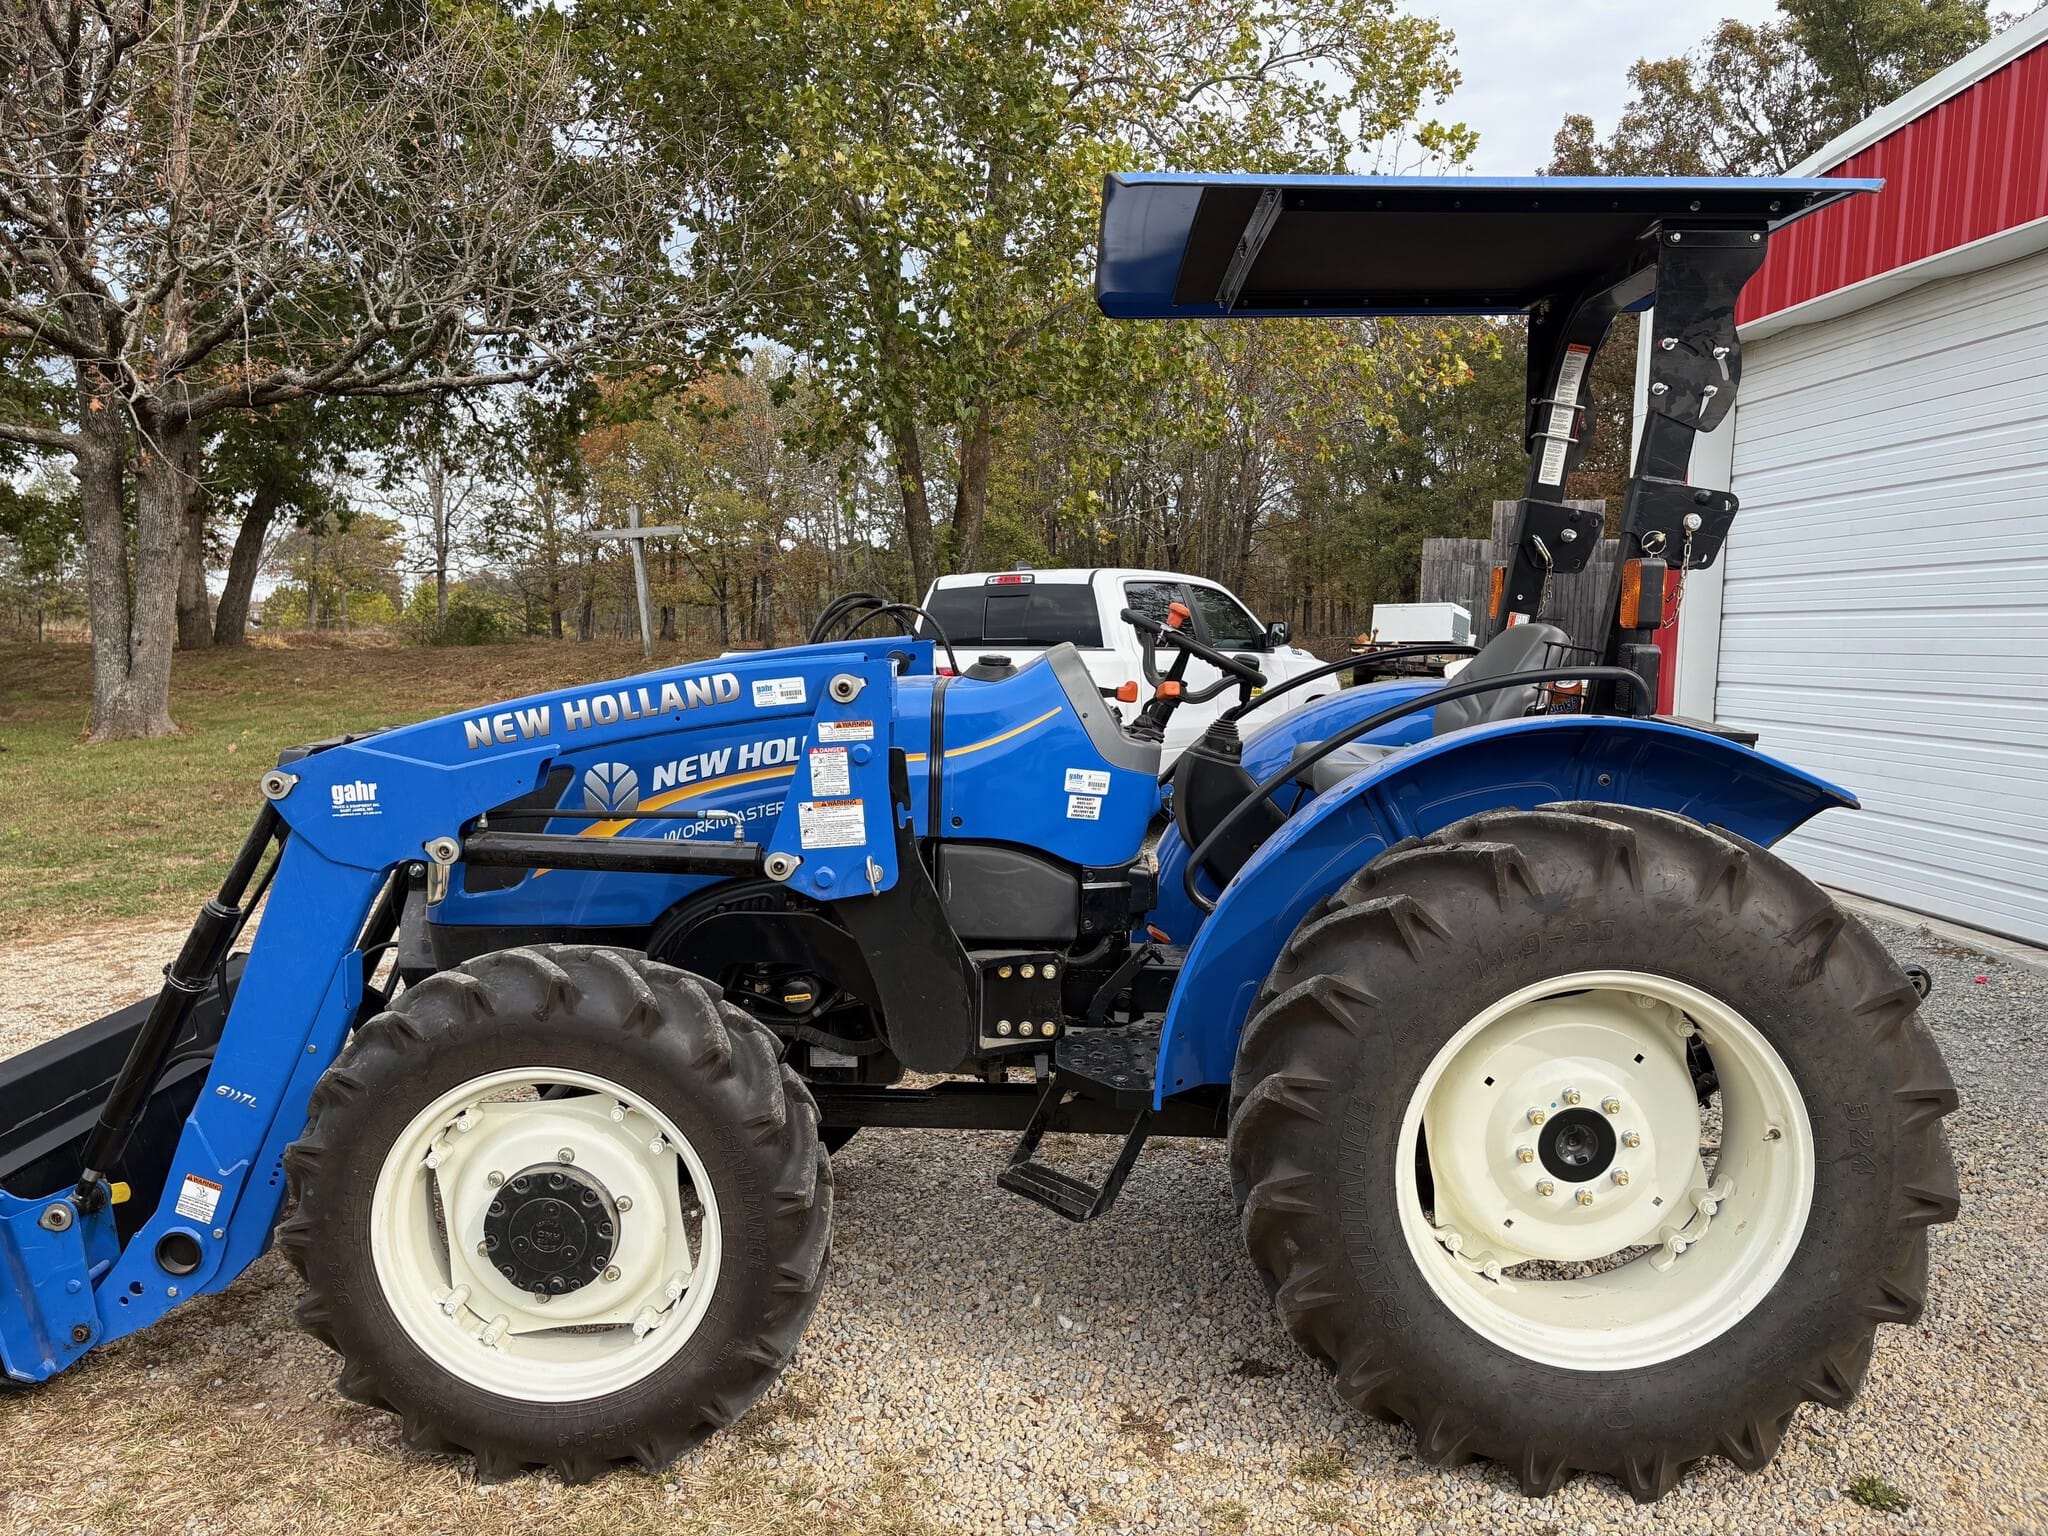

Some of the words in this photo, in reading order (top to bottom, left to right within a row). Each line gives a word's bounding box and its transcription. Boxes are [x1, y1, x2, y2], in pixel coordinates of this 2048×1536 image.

[463, 705, 550, 750] NEW
[562, 673, 740, 731] HOLLAND
[841, 720, 872, 728] WARNING
[652, 747, 731, 792] NEW
[737, 735, 808, 770] HOL
[331, 780, 378, 805] gahr
[216, 1085, 257, 1108] 611TL
[1842, 1102, 1879, 1176] 324
[193, 1175, 222, 1190] WARNING
[1337, 1096, 1399, 1297] ALLIANCE
